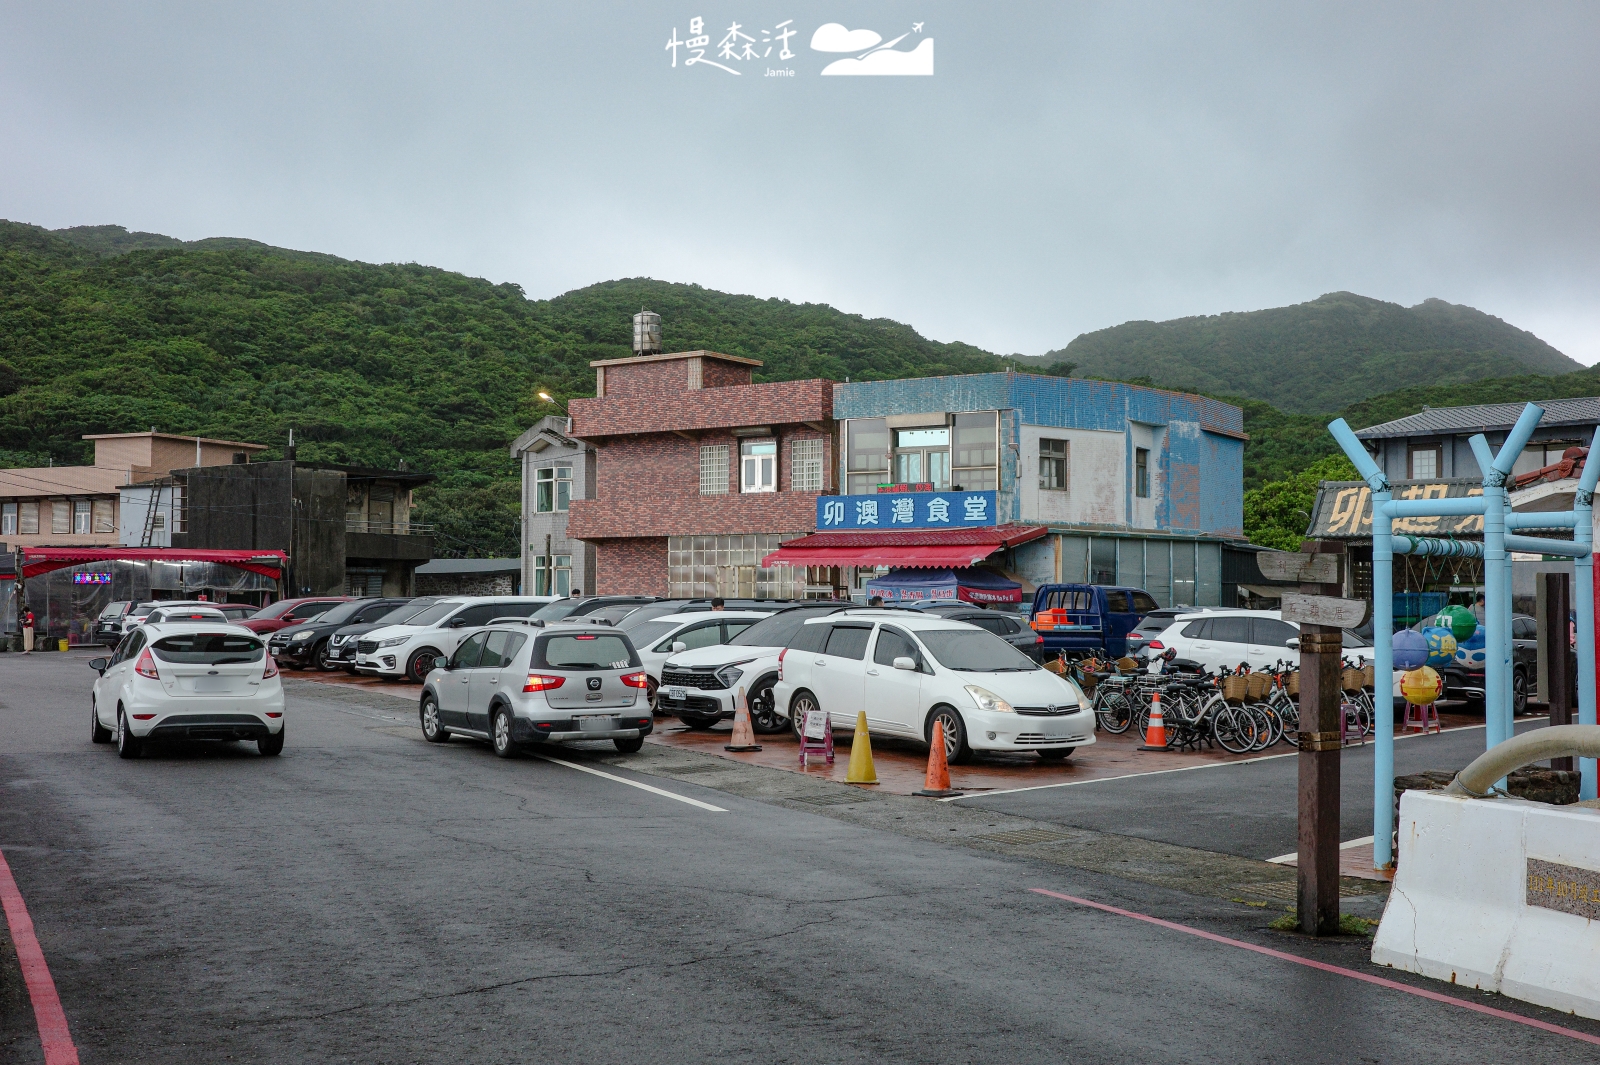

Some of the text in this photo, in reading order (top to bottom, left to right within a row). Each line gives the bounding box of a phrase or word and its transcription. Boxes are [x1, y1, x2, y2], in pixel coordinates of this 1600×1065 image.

[823, 496, 988, 525] 卯澳灣食堂
